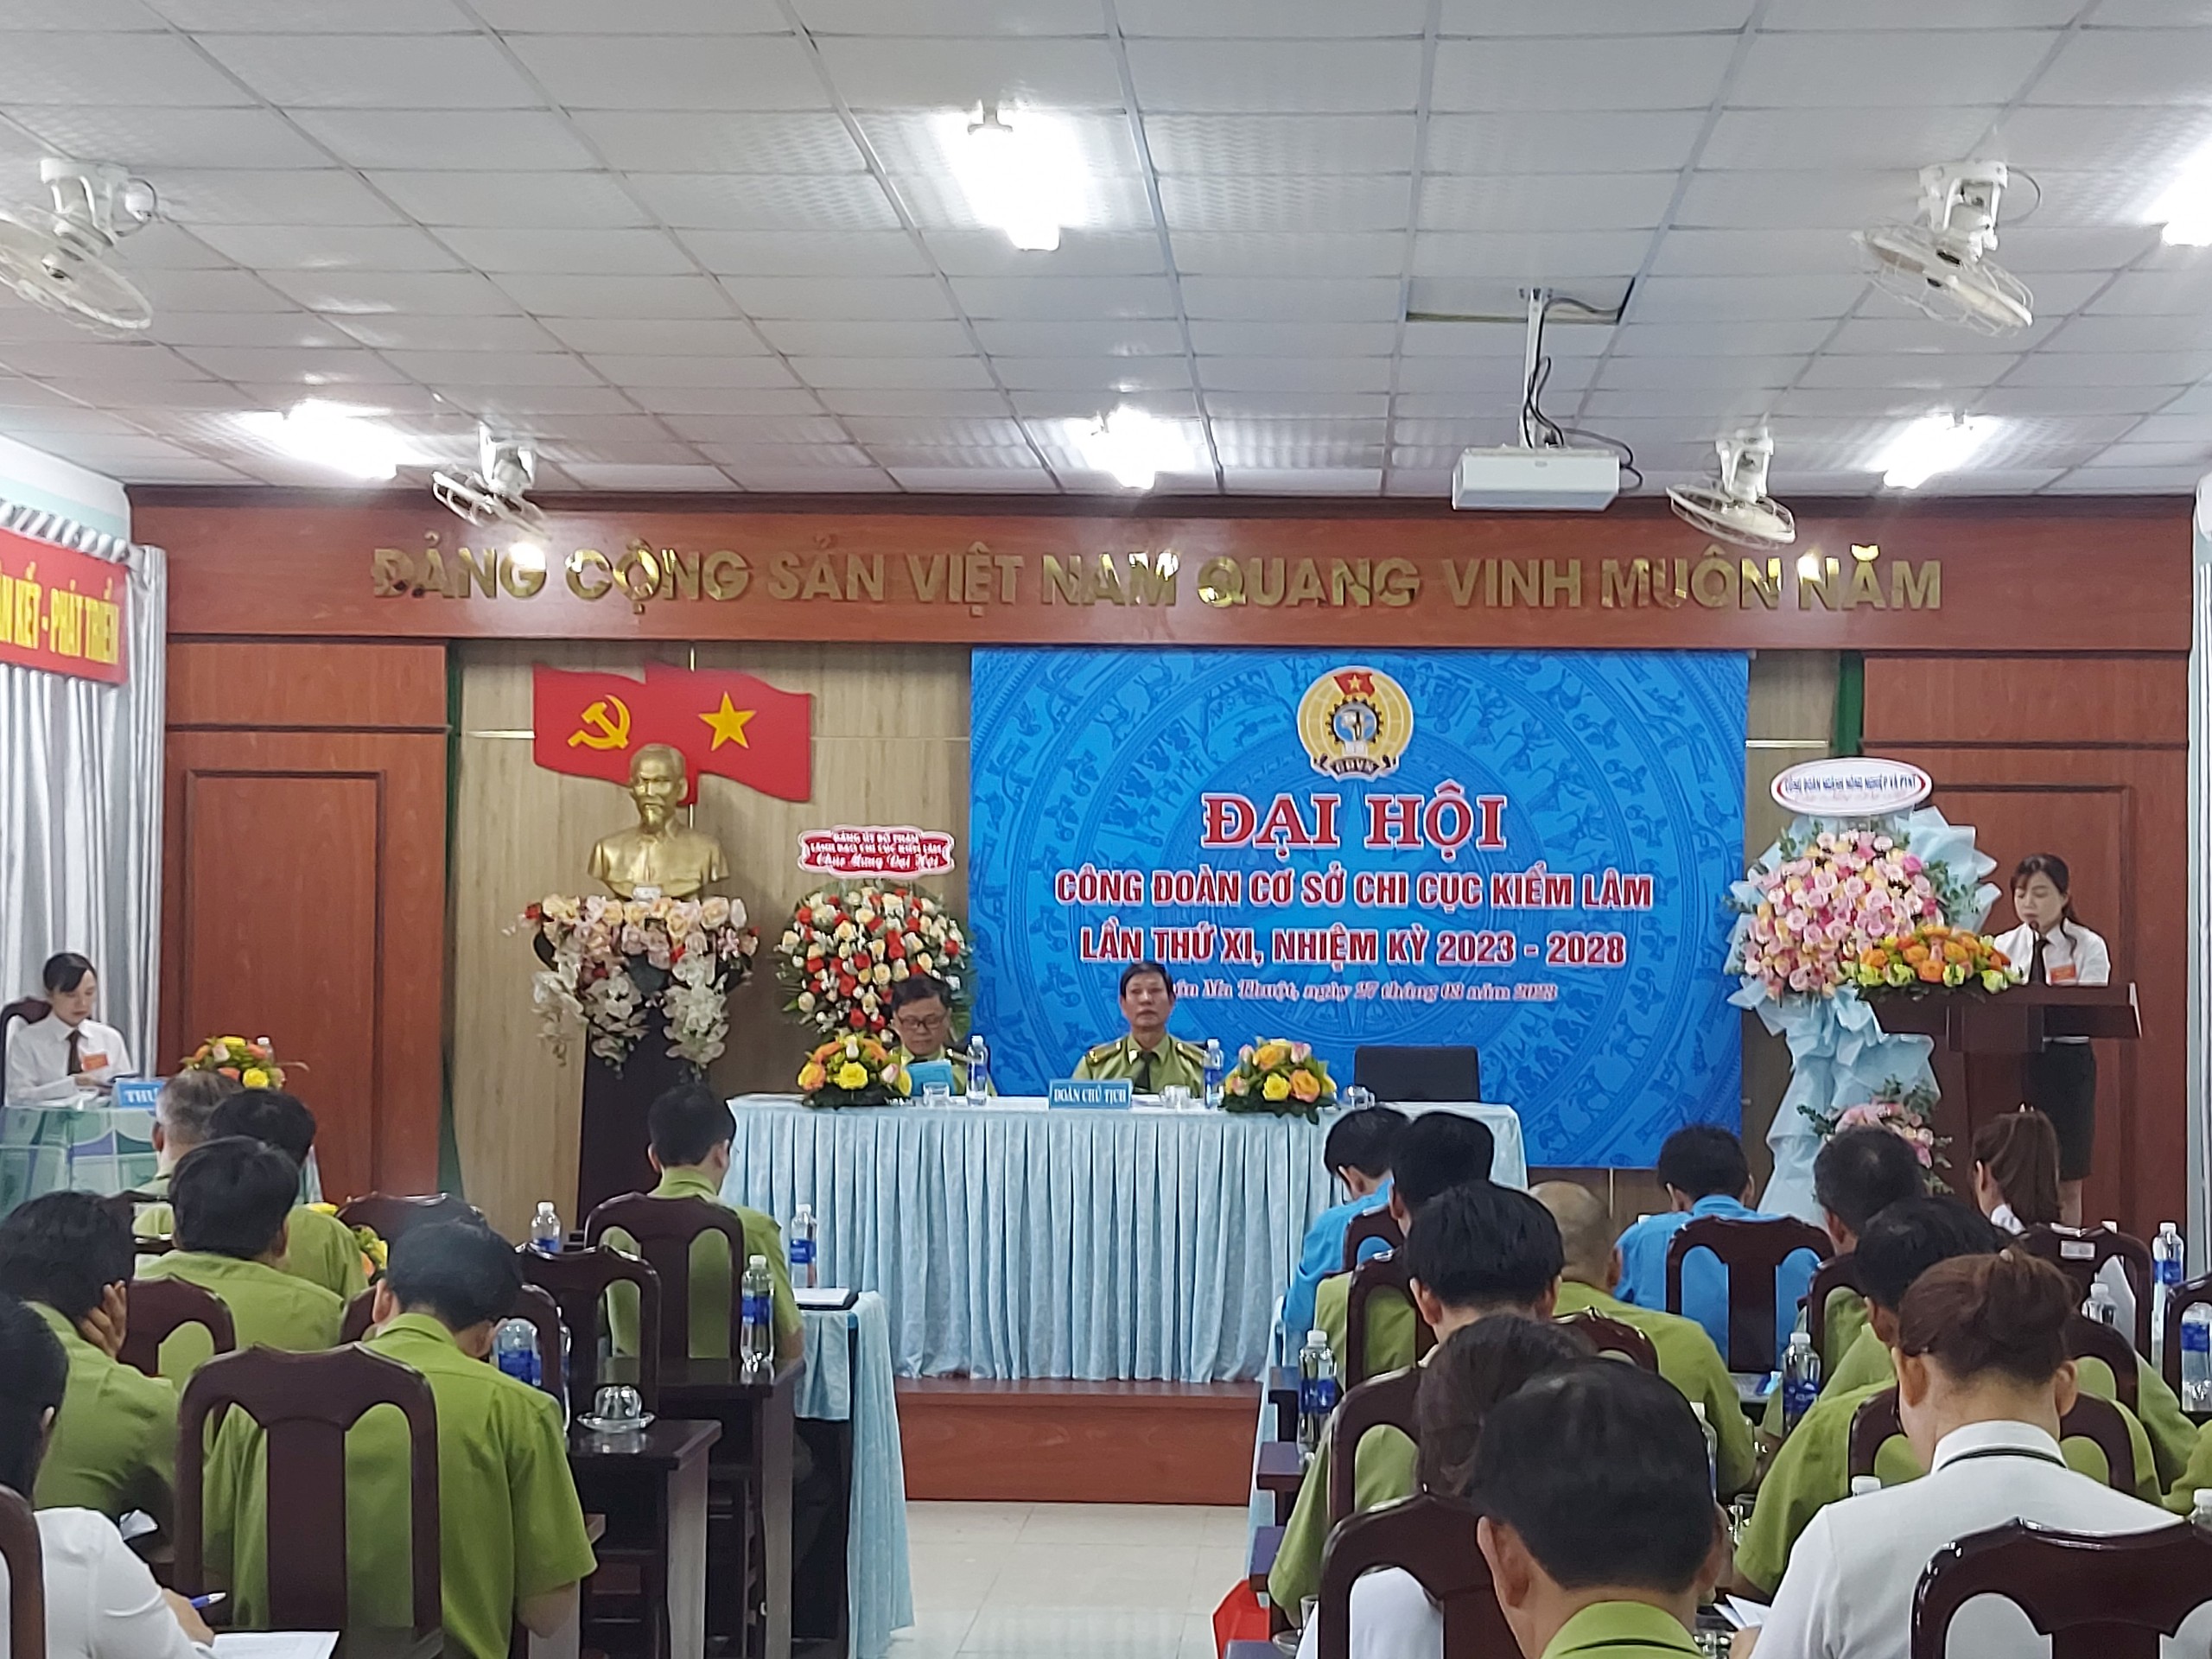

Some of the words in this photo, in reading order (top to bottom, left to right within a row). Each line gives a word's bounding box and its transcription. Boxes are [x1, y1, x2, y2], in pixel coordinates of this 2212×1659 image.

[372, 531, 547, 599] ĐẢNG
[564, 537, 753, 614] CỘNG
[767, 533, 885, 601] SẢN
[906, 541, 1025, 617] VIỆT
[1040, 552, 1179, 606] NAM
[1197, 556, 1421, 608] QUANG
[1441, 558, 1581, 608] VINH
[1600, 543, 1783, 610] MUÔN
[1796, 544, 1942, 610] NĂM
[1204, 795, 1338, 857] ĐẠI
[1365, 781, 1505, 859] HỘI
[1057, 864, 1142, 904] CÔNG
[1153, 865, 1240, 904] ĐOÀN
[1250, 869, 1294, 905] CƠ
[1302, 862, 1345, 905] SỞ
[1355, 872, 1408, 906] CHI
[1417, 873, 1481, 912] CỤC
[1491, 861, 1573, 906] KIỂM
[1584, 868, 1651, 907] LÂM
[1082, 918, 1142, 961] LẦN
[1153, 922, 1214, 961] THỨ
[1222, 928, 1262, 965] XI,
[1274, 923, 1377, 971] NHIỆM
[1388, 923, 1427, 963] KỲ
[1438, 931, 1515, 964] 2023
[1524, 944, 1538, 956] -
[1547, 932, 1625, 966] 2028
[1467, 982, 1510, 1000] năm
